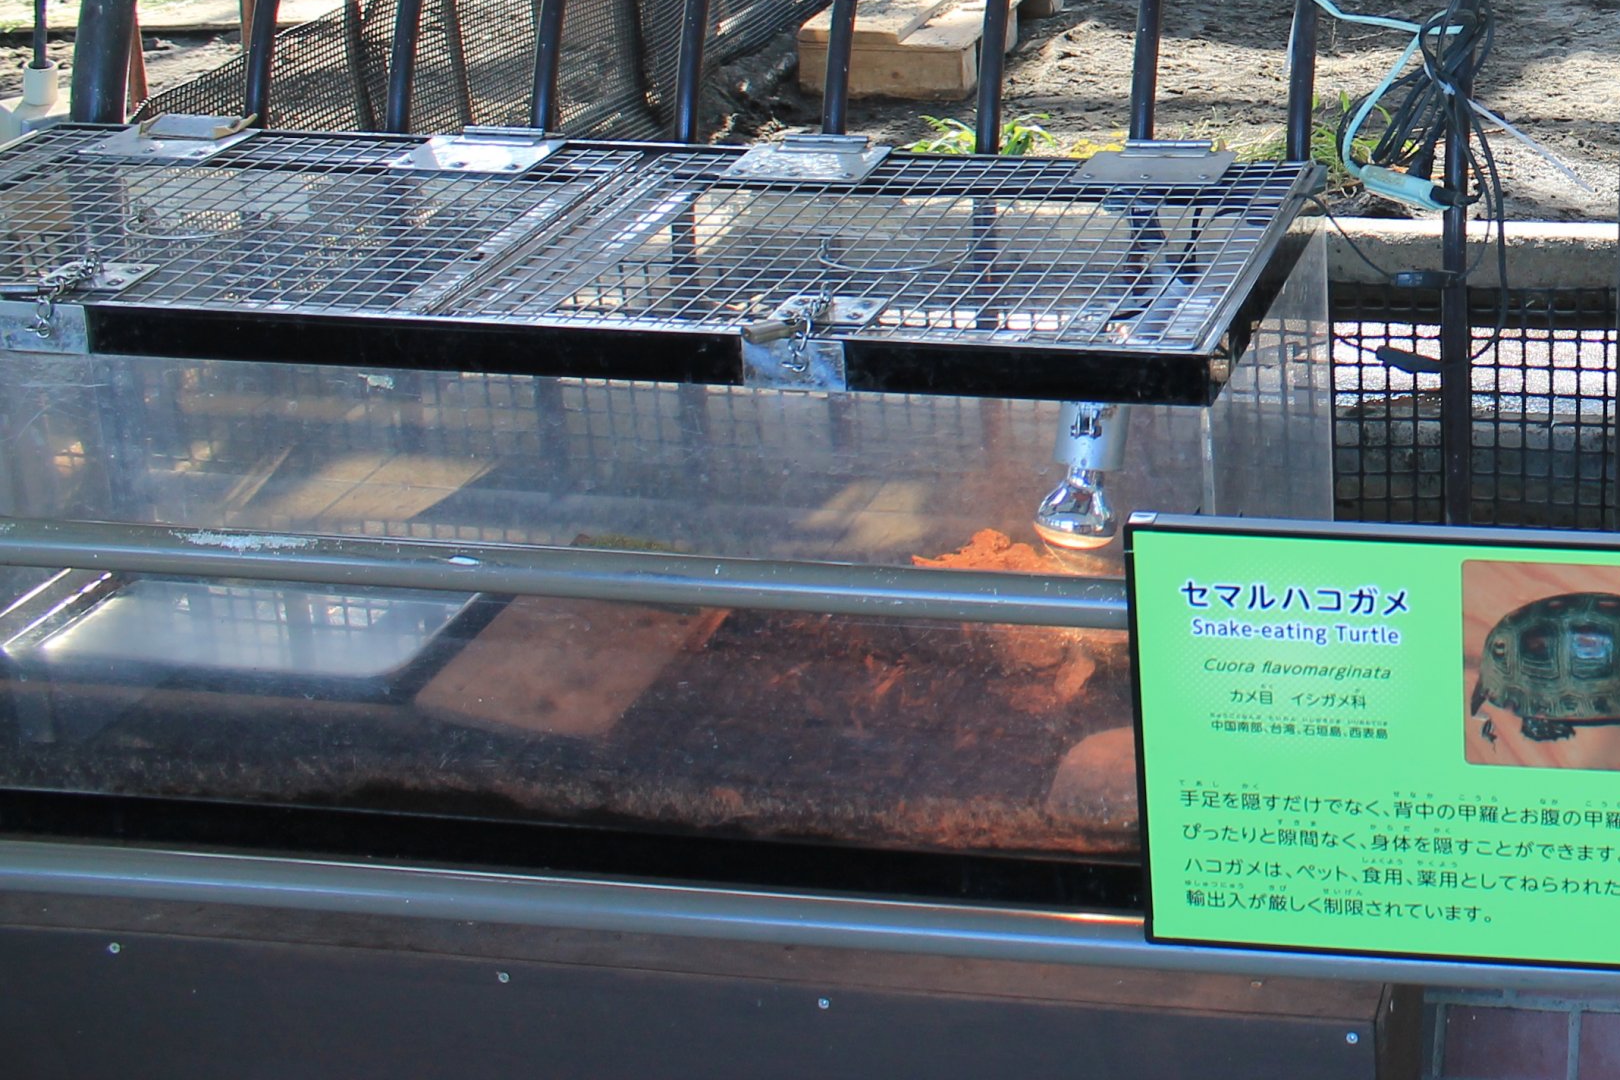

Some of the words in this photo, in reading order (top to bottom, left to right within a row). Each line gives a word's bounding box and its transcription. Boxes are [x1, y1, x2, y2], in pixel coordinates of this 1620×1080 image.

[1181, 581, 1409, 615] セマルハコガメ
[1192, 619, 1327, 645] Snake-eating
[1335, 625, 1399, 644] Turtle
[1204, 658, 1255, 673] Cuora
[1262, 661, 1392, 681] flavomarginata
[1231, 689, 1273, 705] カメ目
[1291, 694, 1366, 709] イシガメ科
[1187, 889, 1492, 923] 輸出入が厳しく制限されています。
